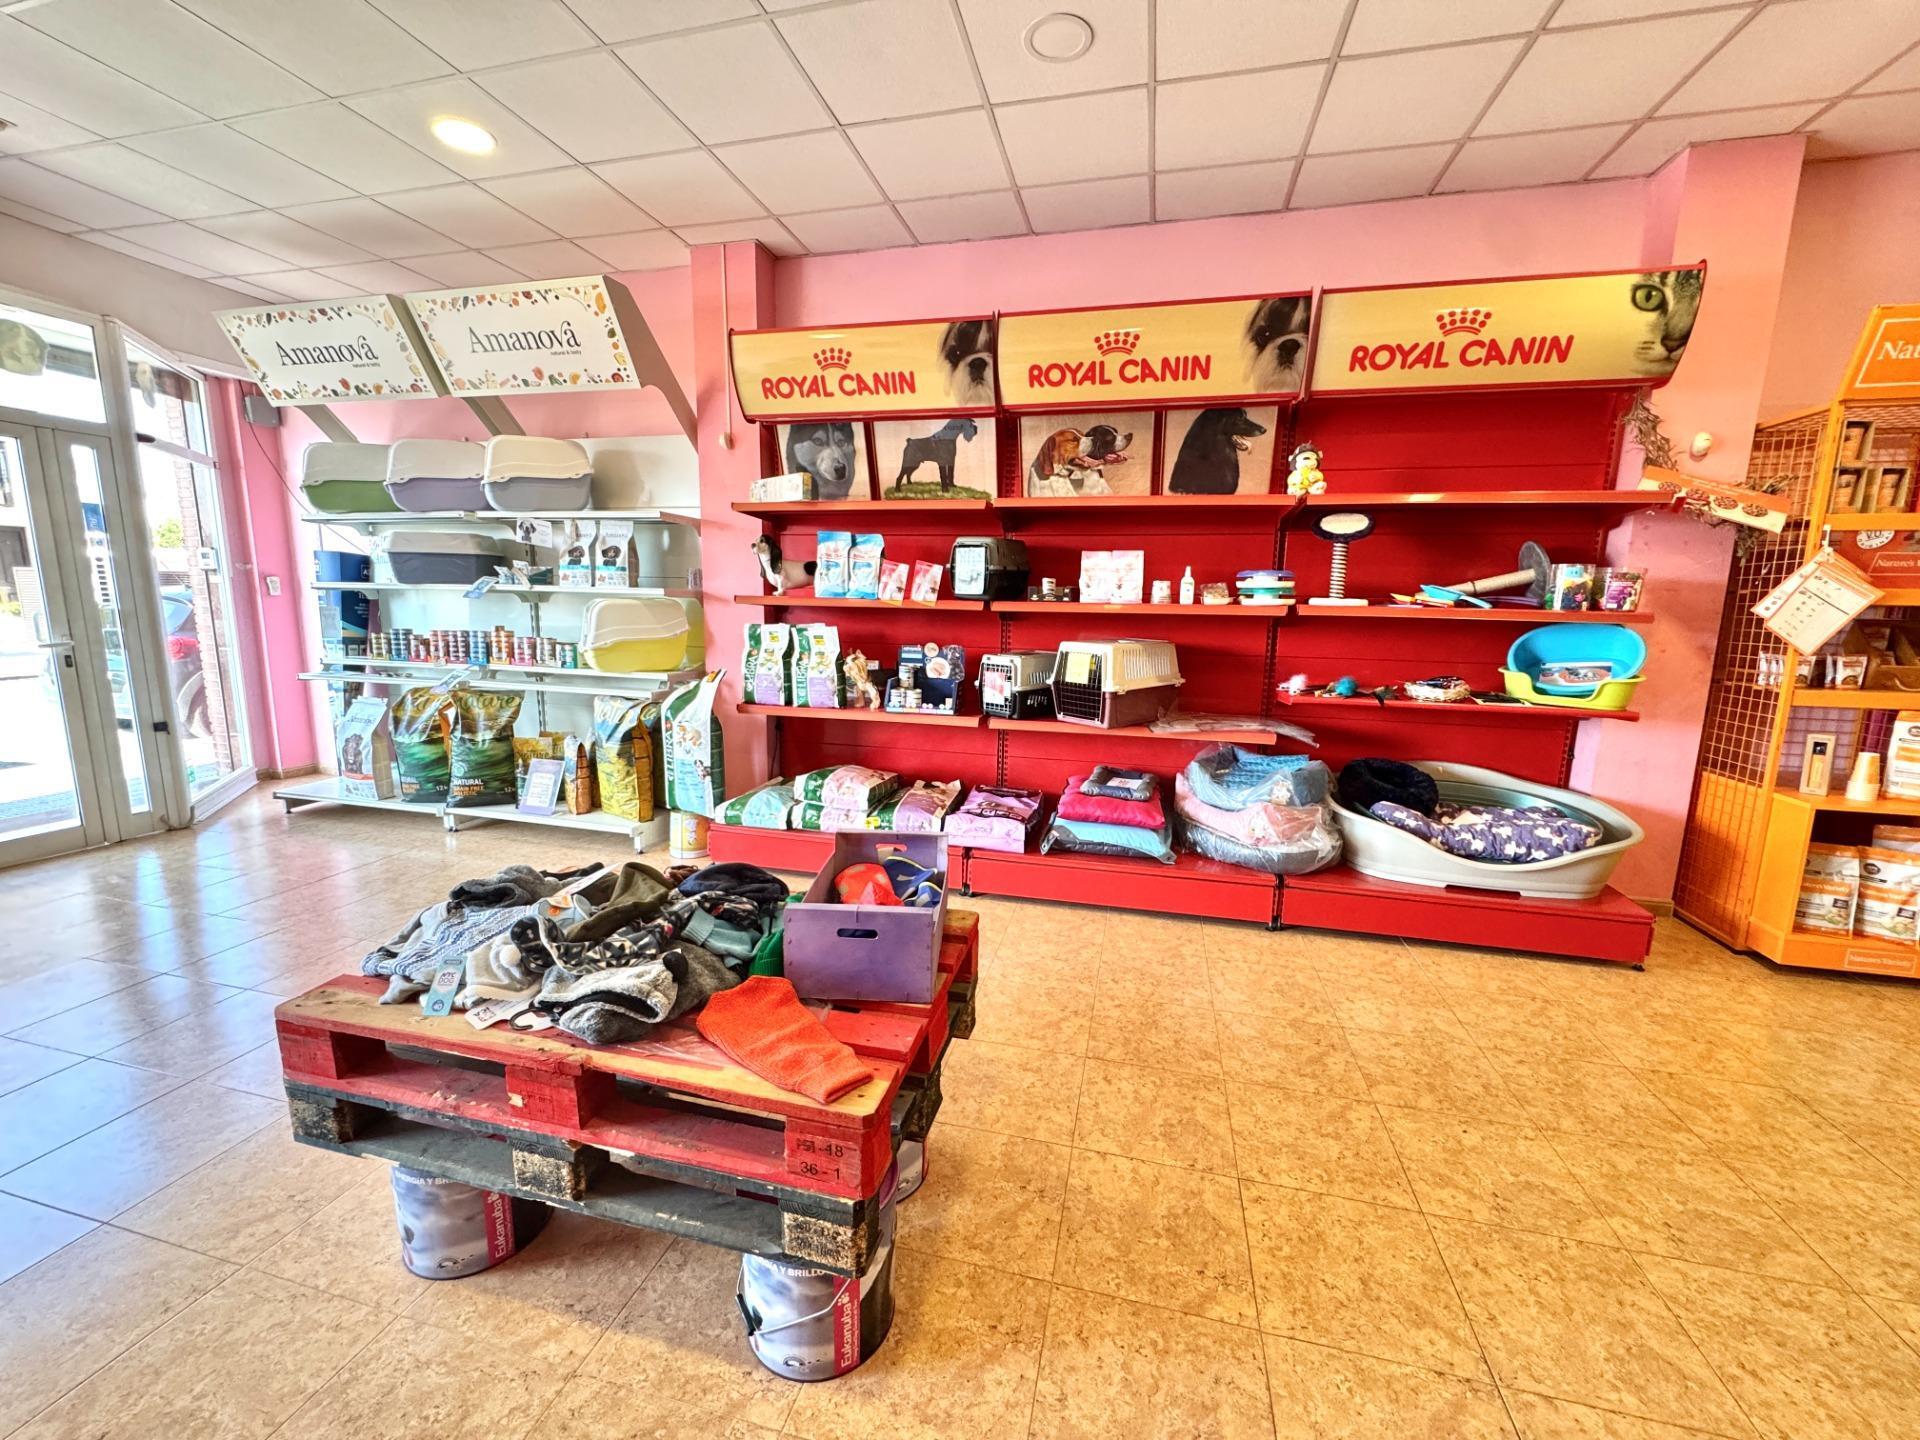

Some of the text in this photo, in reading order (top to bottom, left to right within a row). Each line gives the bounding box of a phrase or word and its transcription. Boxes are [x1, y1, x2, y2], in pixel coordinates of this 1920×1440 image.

[1028, 354, 1212, 389] ROYAL CANIN
[1349, 335, 1575, 372] ROYAL CANIN
[761, 370, 916, 400] ROYAL CANIN
[800, 1161, 818, 1176] 36
[492, 1198, 507, 1258] Eukanuba
[840, 1302, 852, 1368] Eukanuba
